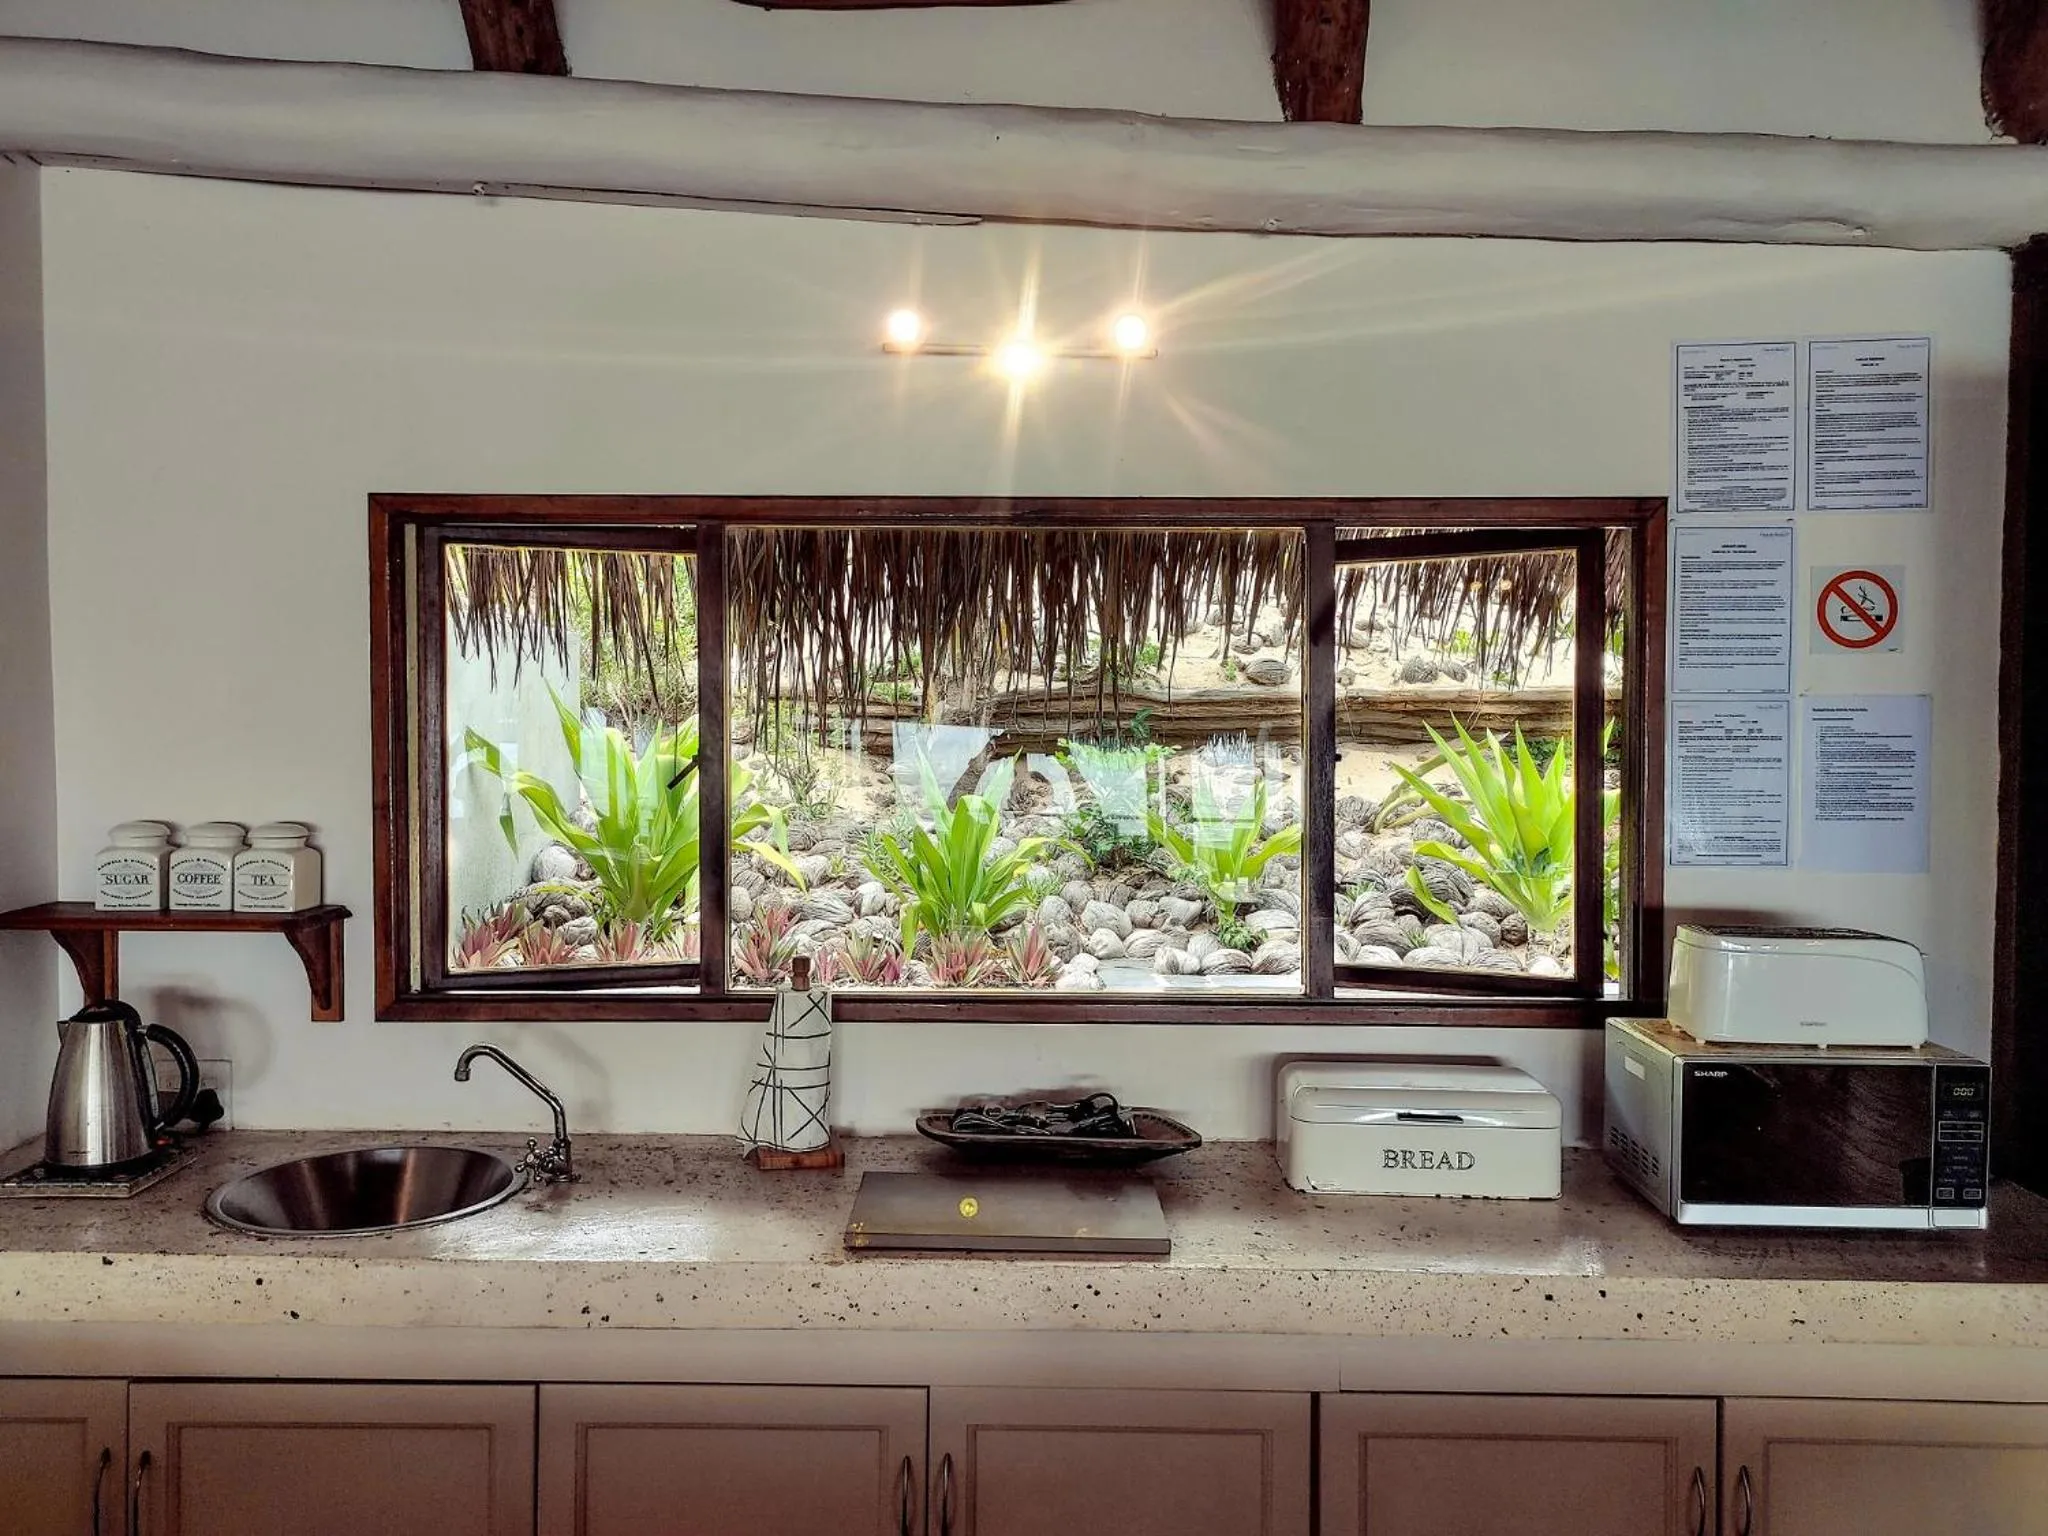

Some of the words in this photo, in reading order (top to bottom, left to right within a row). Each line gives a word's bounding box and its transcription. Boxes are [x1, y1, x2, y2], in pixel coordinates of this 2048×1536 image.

[105, 874, 150, 885] SUGAR
[177, 873, 221, 884] COFFEE
[251, 874, 276, 886] TEA
[1694, 1070, 1729, 1078] SHARP
[1382, 1149, 1476, 1171] BREAD
